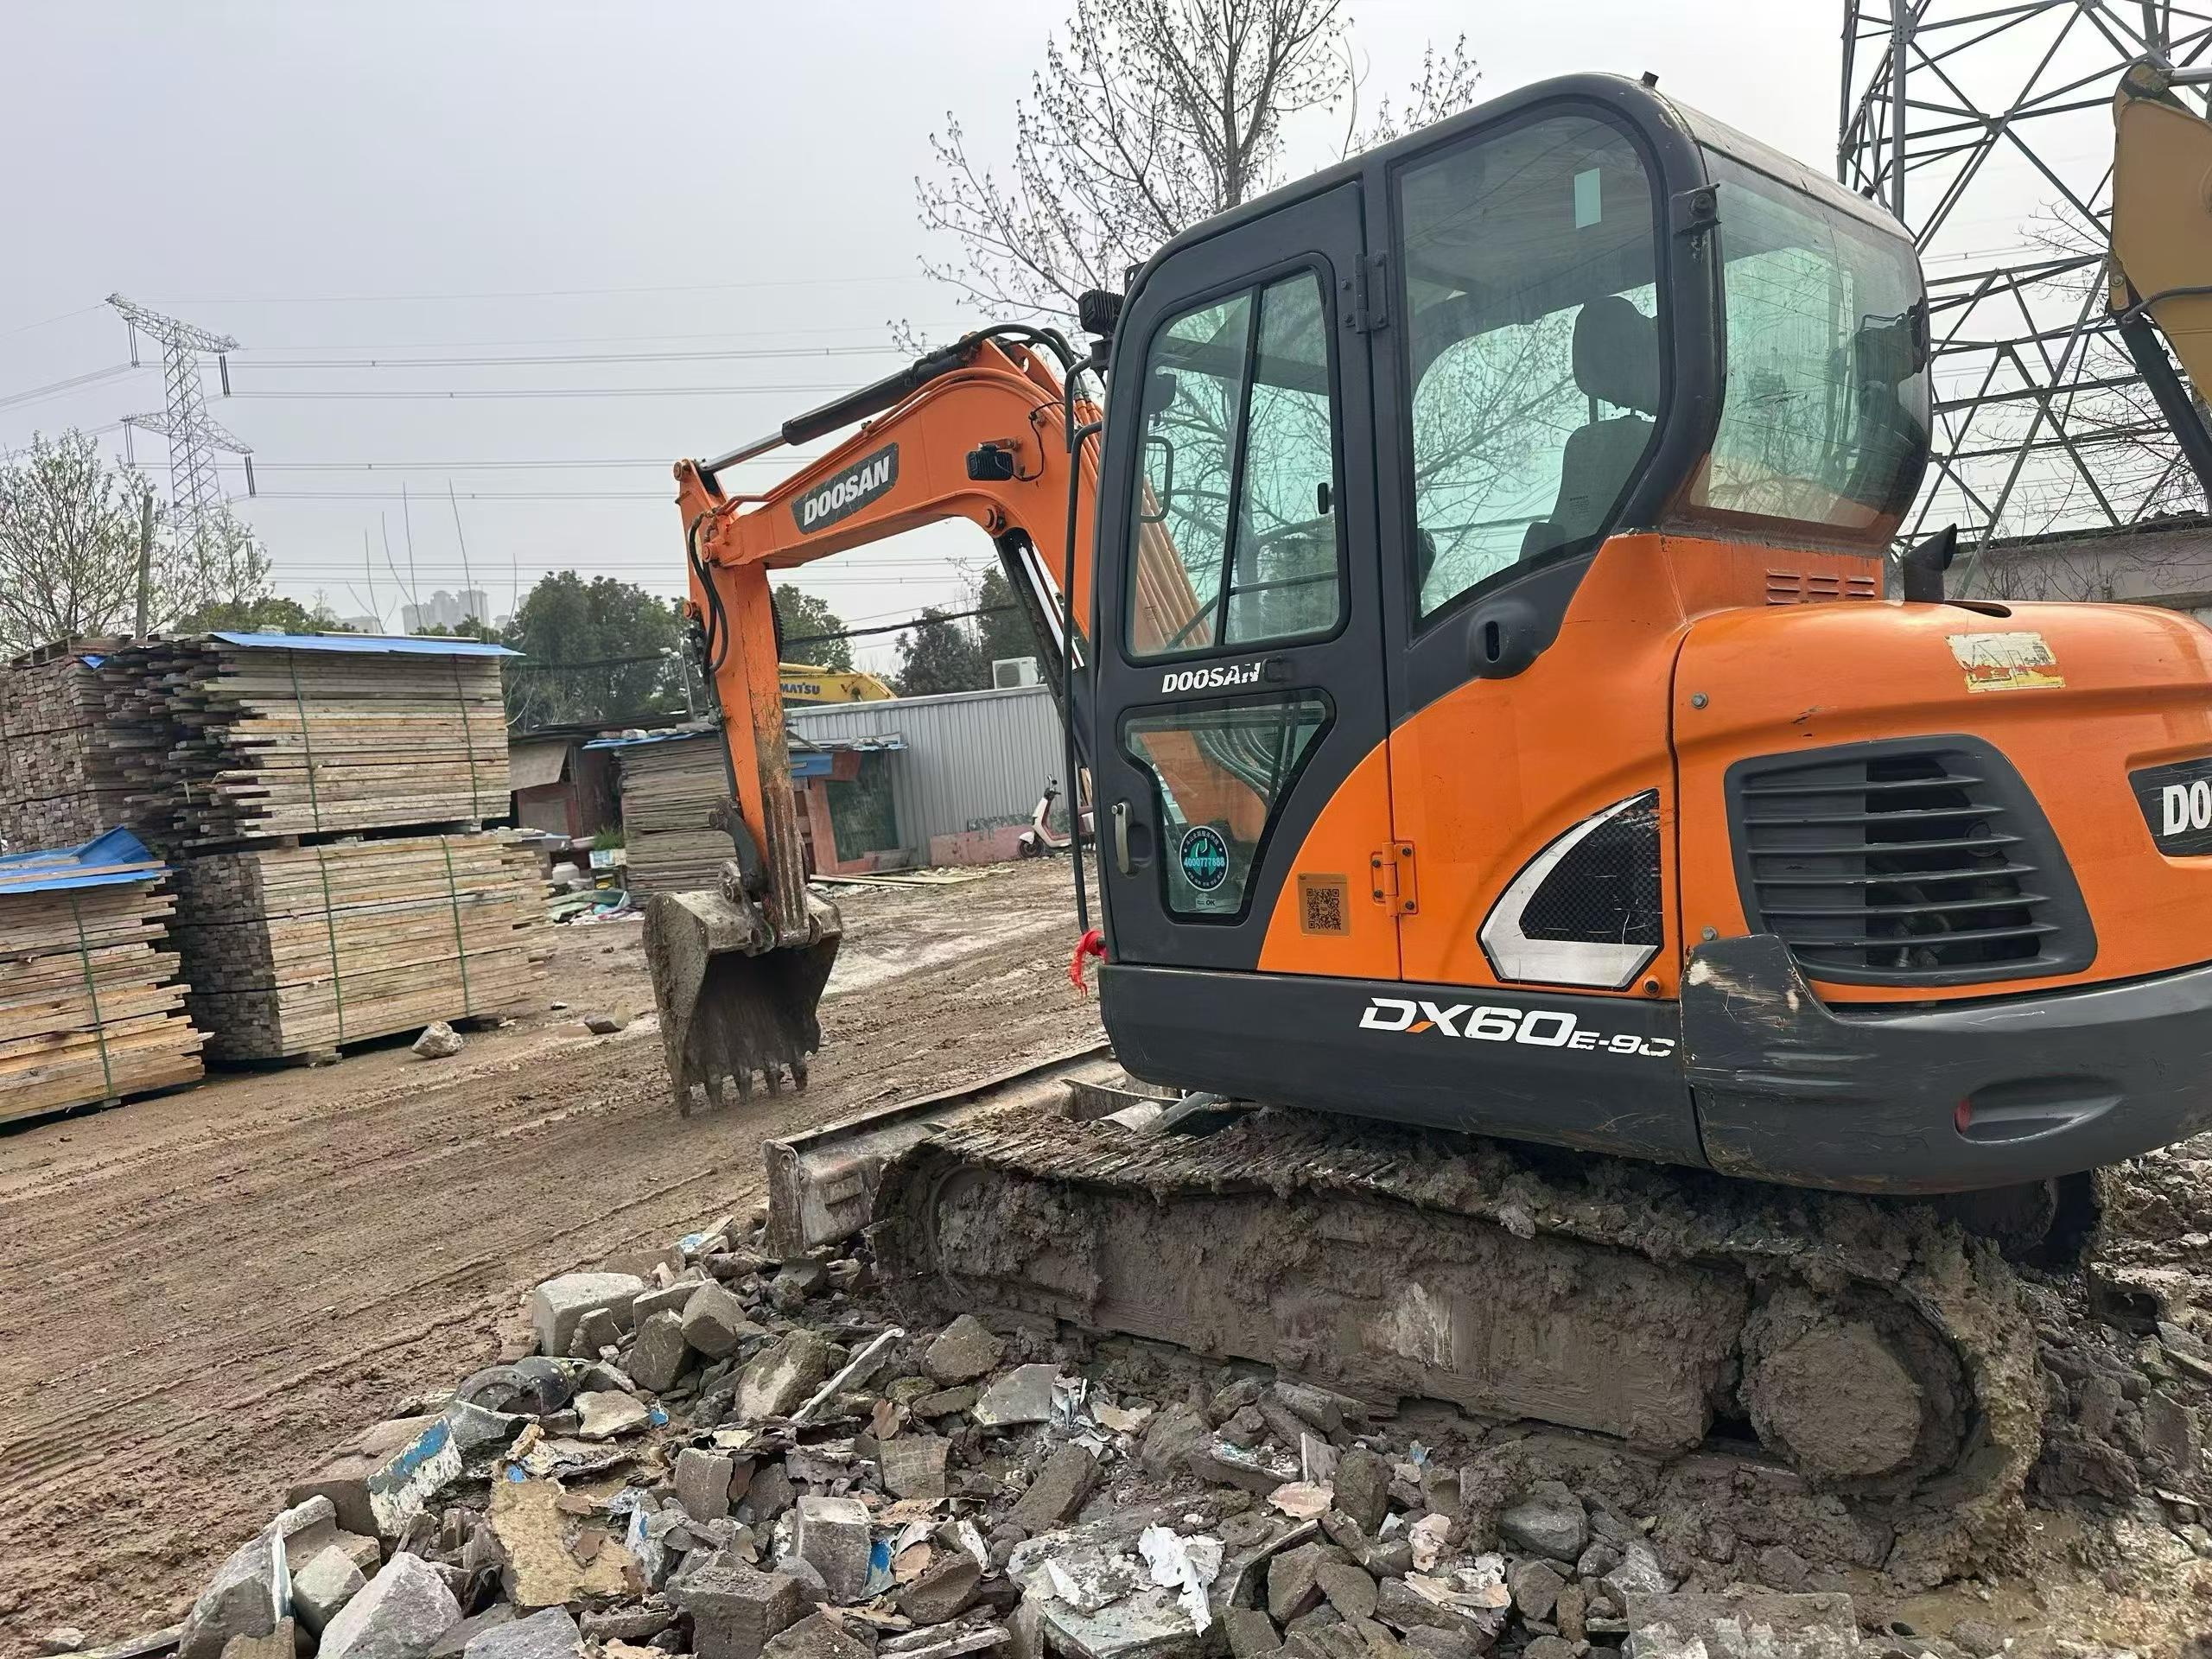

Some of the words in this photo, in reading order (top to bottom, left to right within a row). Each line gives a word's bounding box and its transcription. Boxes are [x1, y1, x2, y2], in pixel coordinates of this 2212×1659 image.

[804, 455, 890, 526] DOOSAN
[779, 682, 821, 695] MATSU
[1161, 662, 1261, 693] DOOSAN
[2163, 780, 2212, 836] DO
